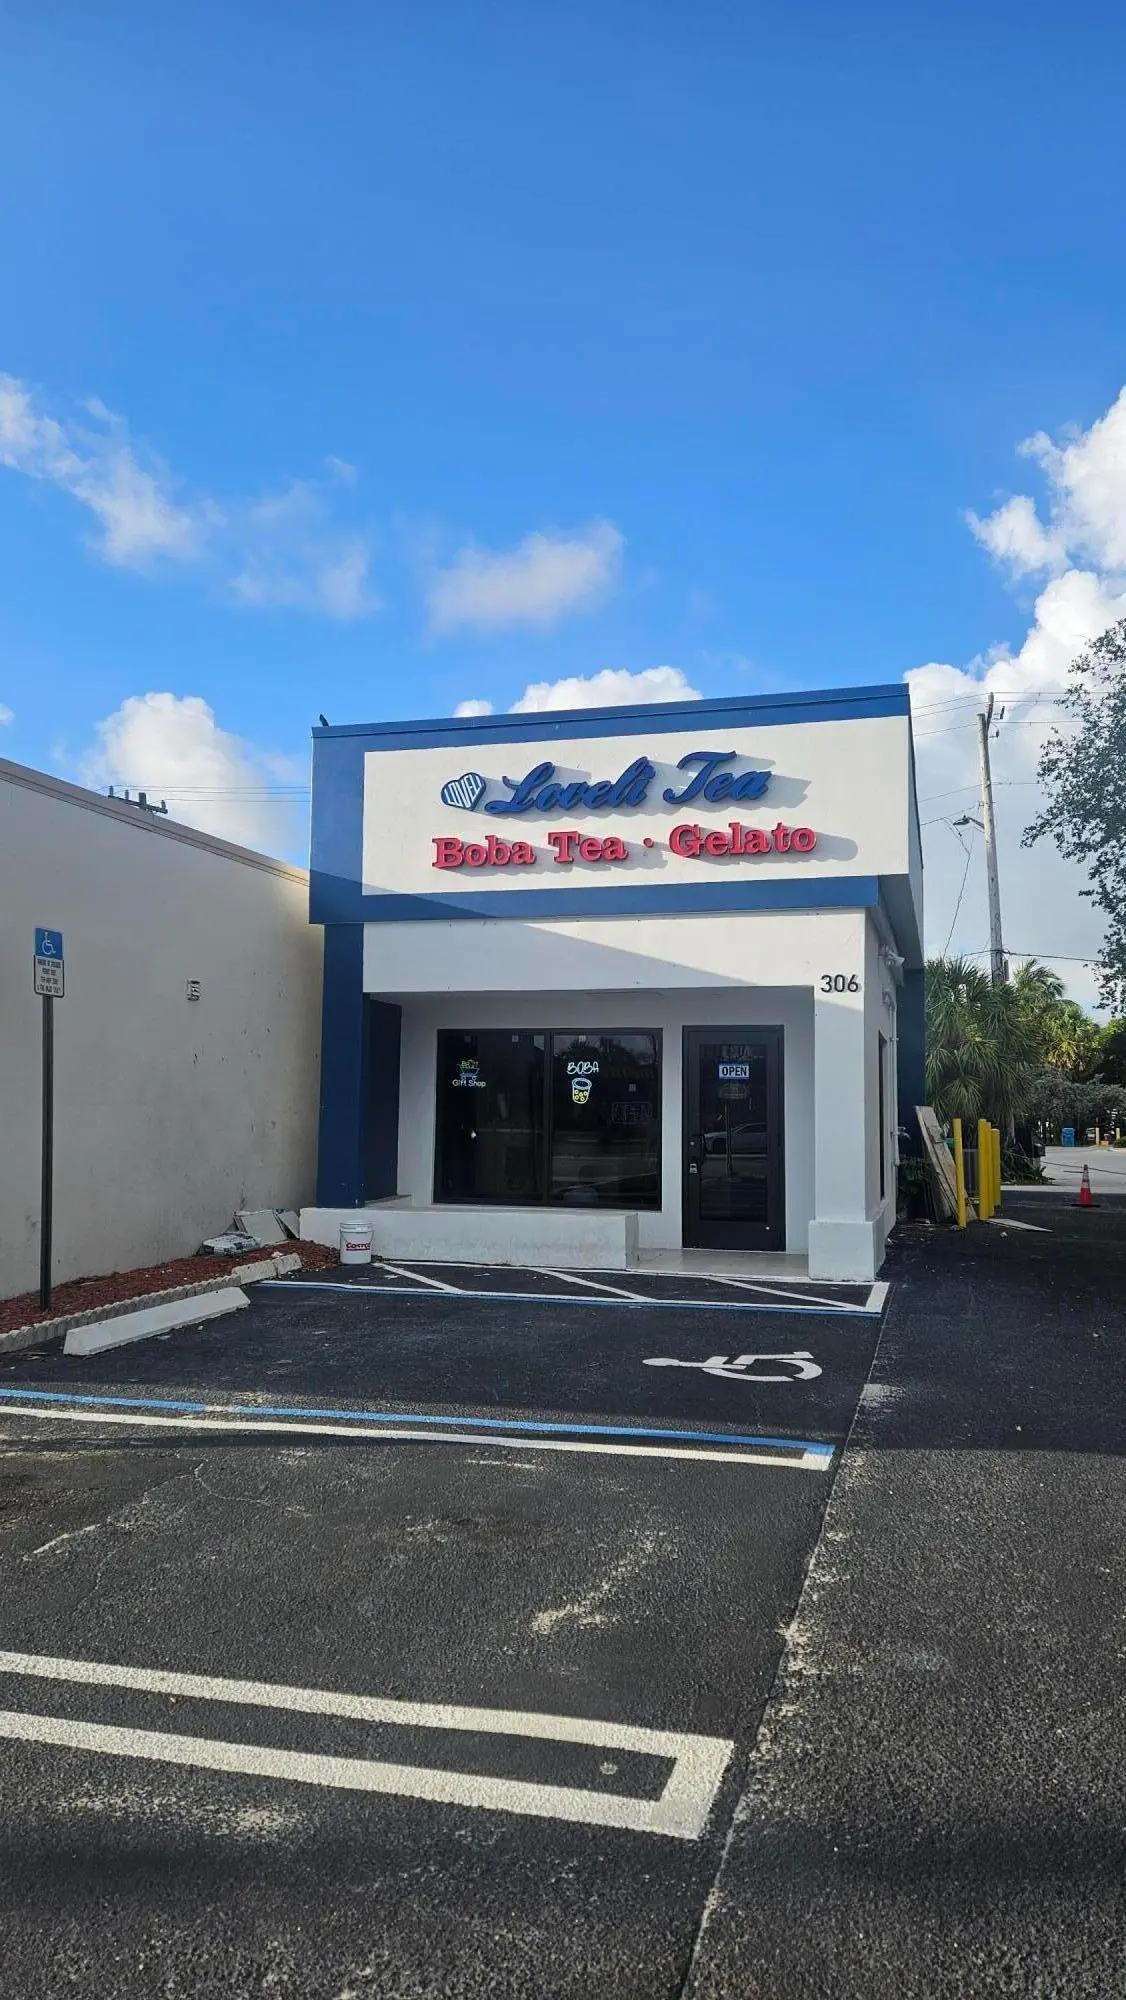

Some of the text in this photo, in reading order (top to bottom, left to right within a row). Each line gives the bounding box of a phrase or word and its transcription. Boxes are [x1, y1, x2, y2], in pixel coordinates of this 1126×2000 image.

[485, 750, 772, 815] Loveli Tea
[431, 835, 536, 869] Boba
[547, 830, 629, 863] Tea
[668, 821, 817, 858] Gelato
[820, 974, 860, 993] 306
[566, 1061, 600, 1075] BOBA
[721, 1066, 747, 1077] OPEN
[452, 1079, 487, 1088] Gift Shop
